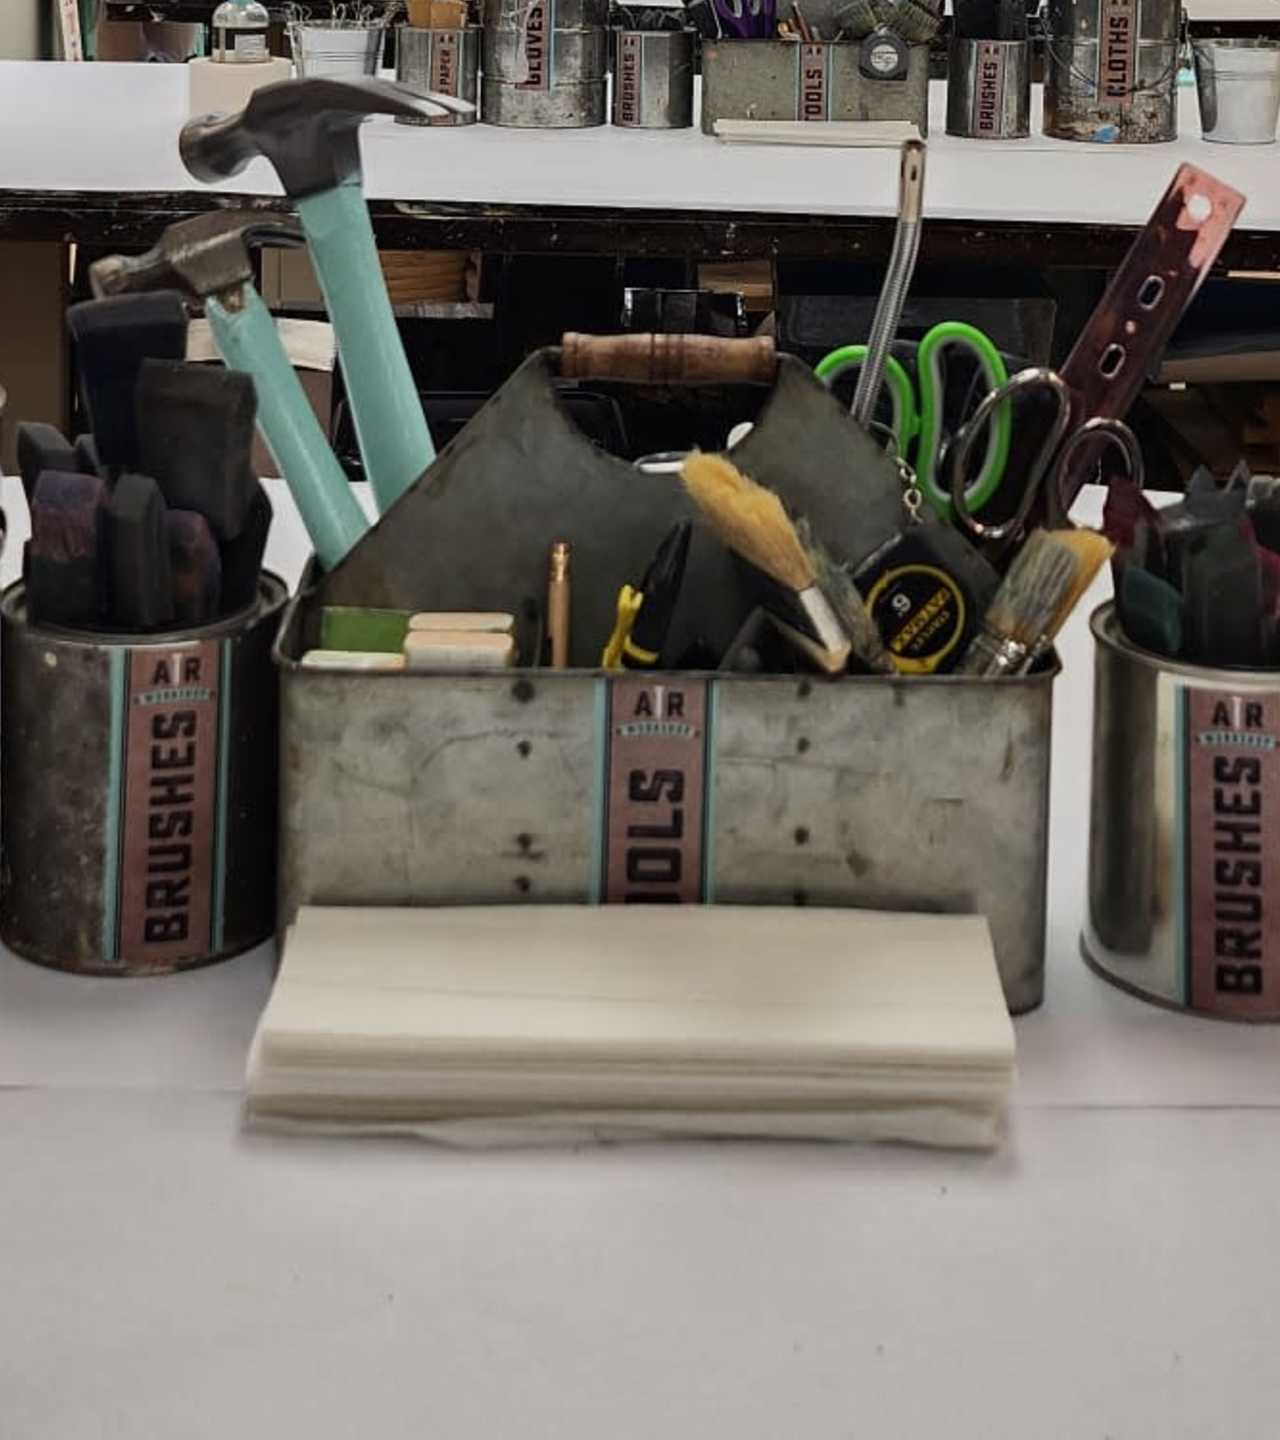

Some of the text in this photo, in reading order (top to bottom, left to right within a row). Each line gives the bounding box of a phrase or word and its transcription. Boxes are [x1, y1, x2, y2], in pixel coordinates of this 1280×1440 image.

[621, 52, 637, 123] BRUSHES
[979, 61, 999, 132] BRUSHES
[1106, 15, 1130, 98] CLOTHS
[144, 710, 197, 944] BRUSHES
[1212, 755, 1264, 996] BRUSHES
